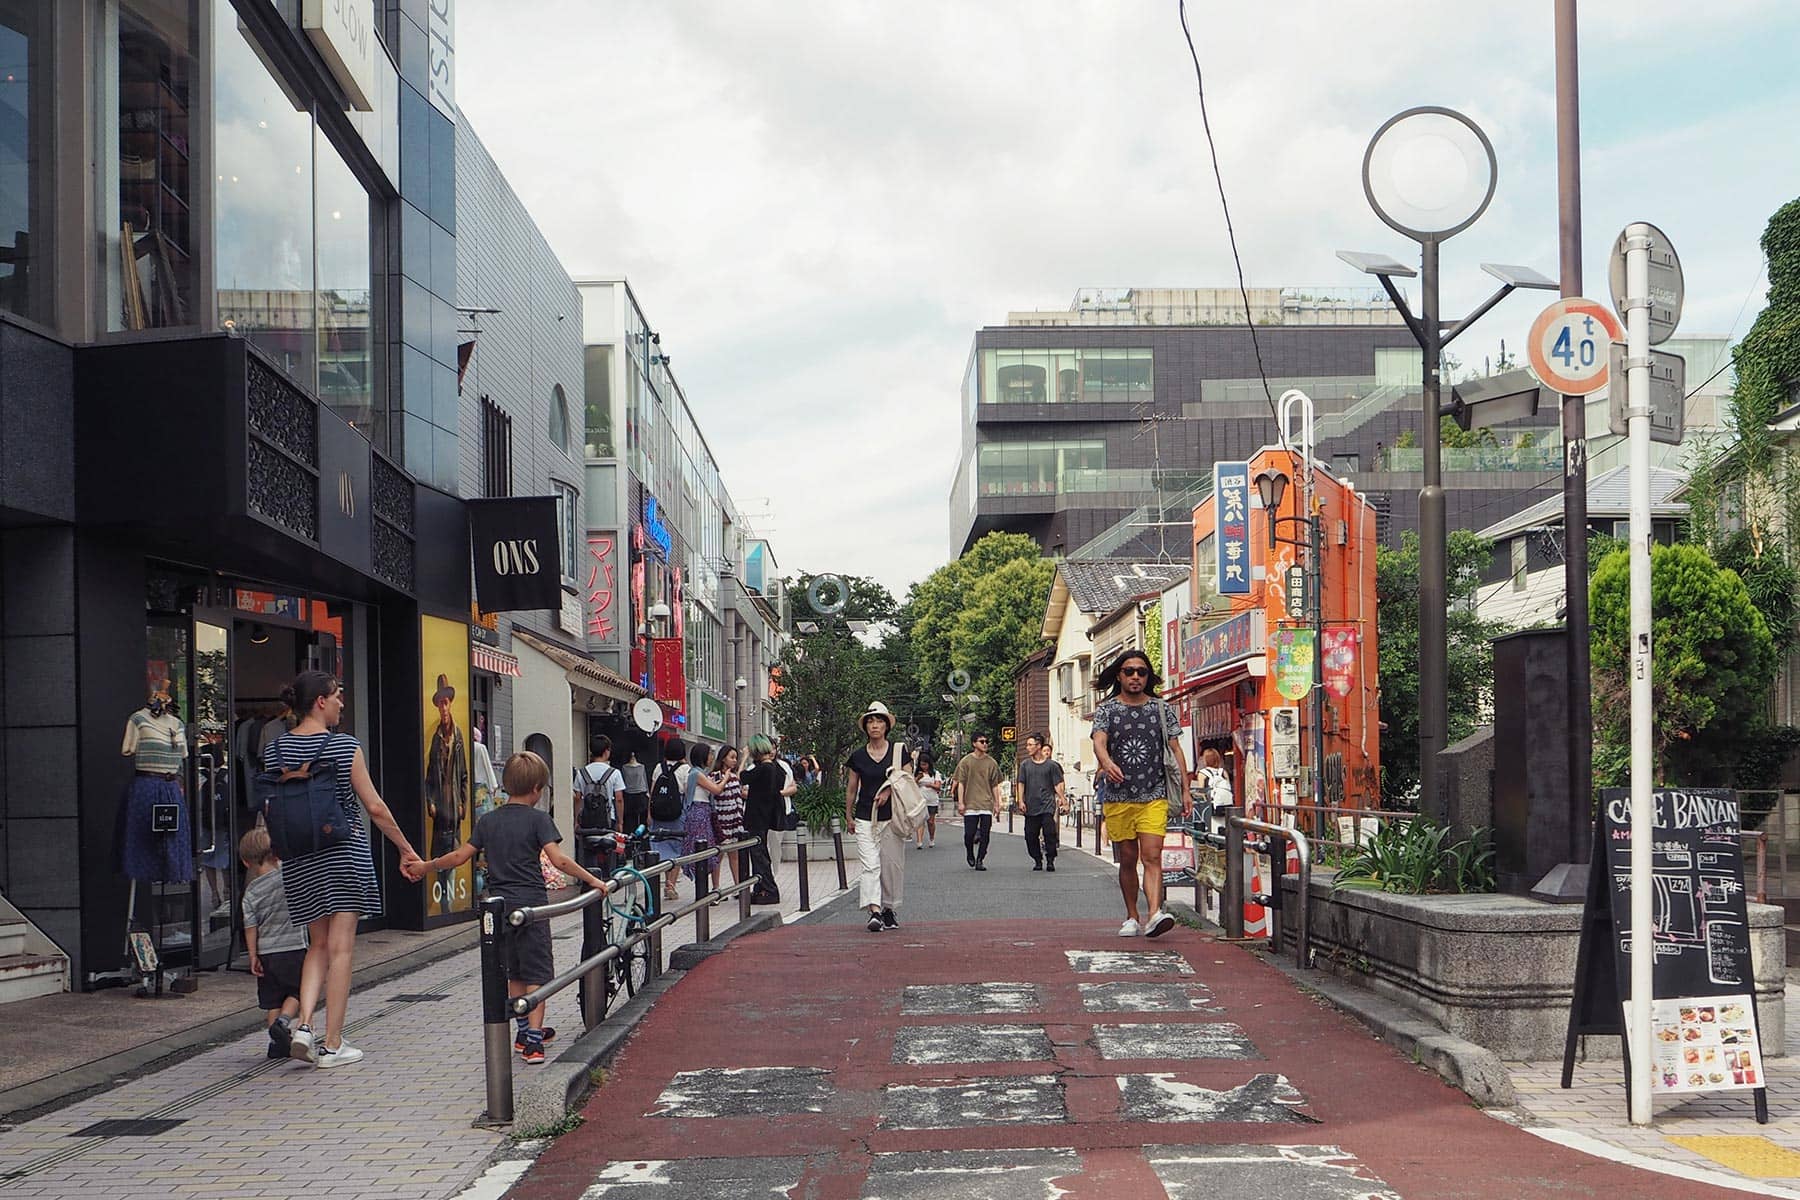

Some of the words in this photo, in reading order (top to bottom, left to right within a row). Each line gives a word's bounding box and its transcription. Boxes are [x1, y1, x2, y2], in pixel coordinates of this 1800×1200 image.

[1552, 326, 1594, 371] 4.0
[493, 539, 540, 576] ONS
[587, 538, 614, 641] マバタキ
[1608, 792, 1667, 829] CAE
[1670, 791, 1738, 829] BANYAN
